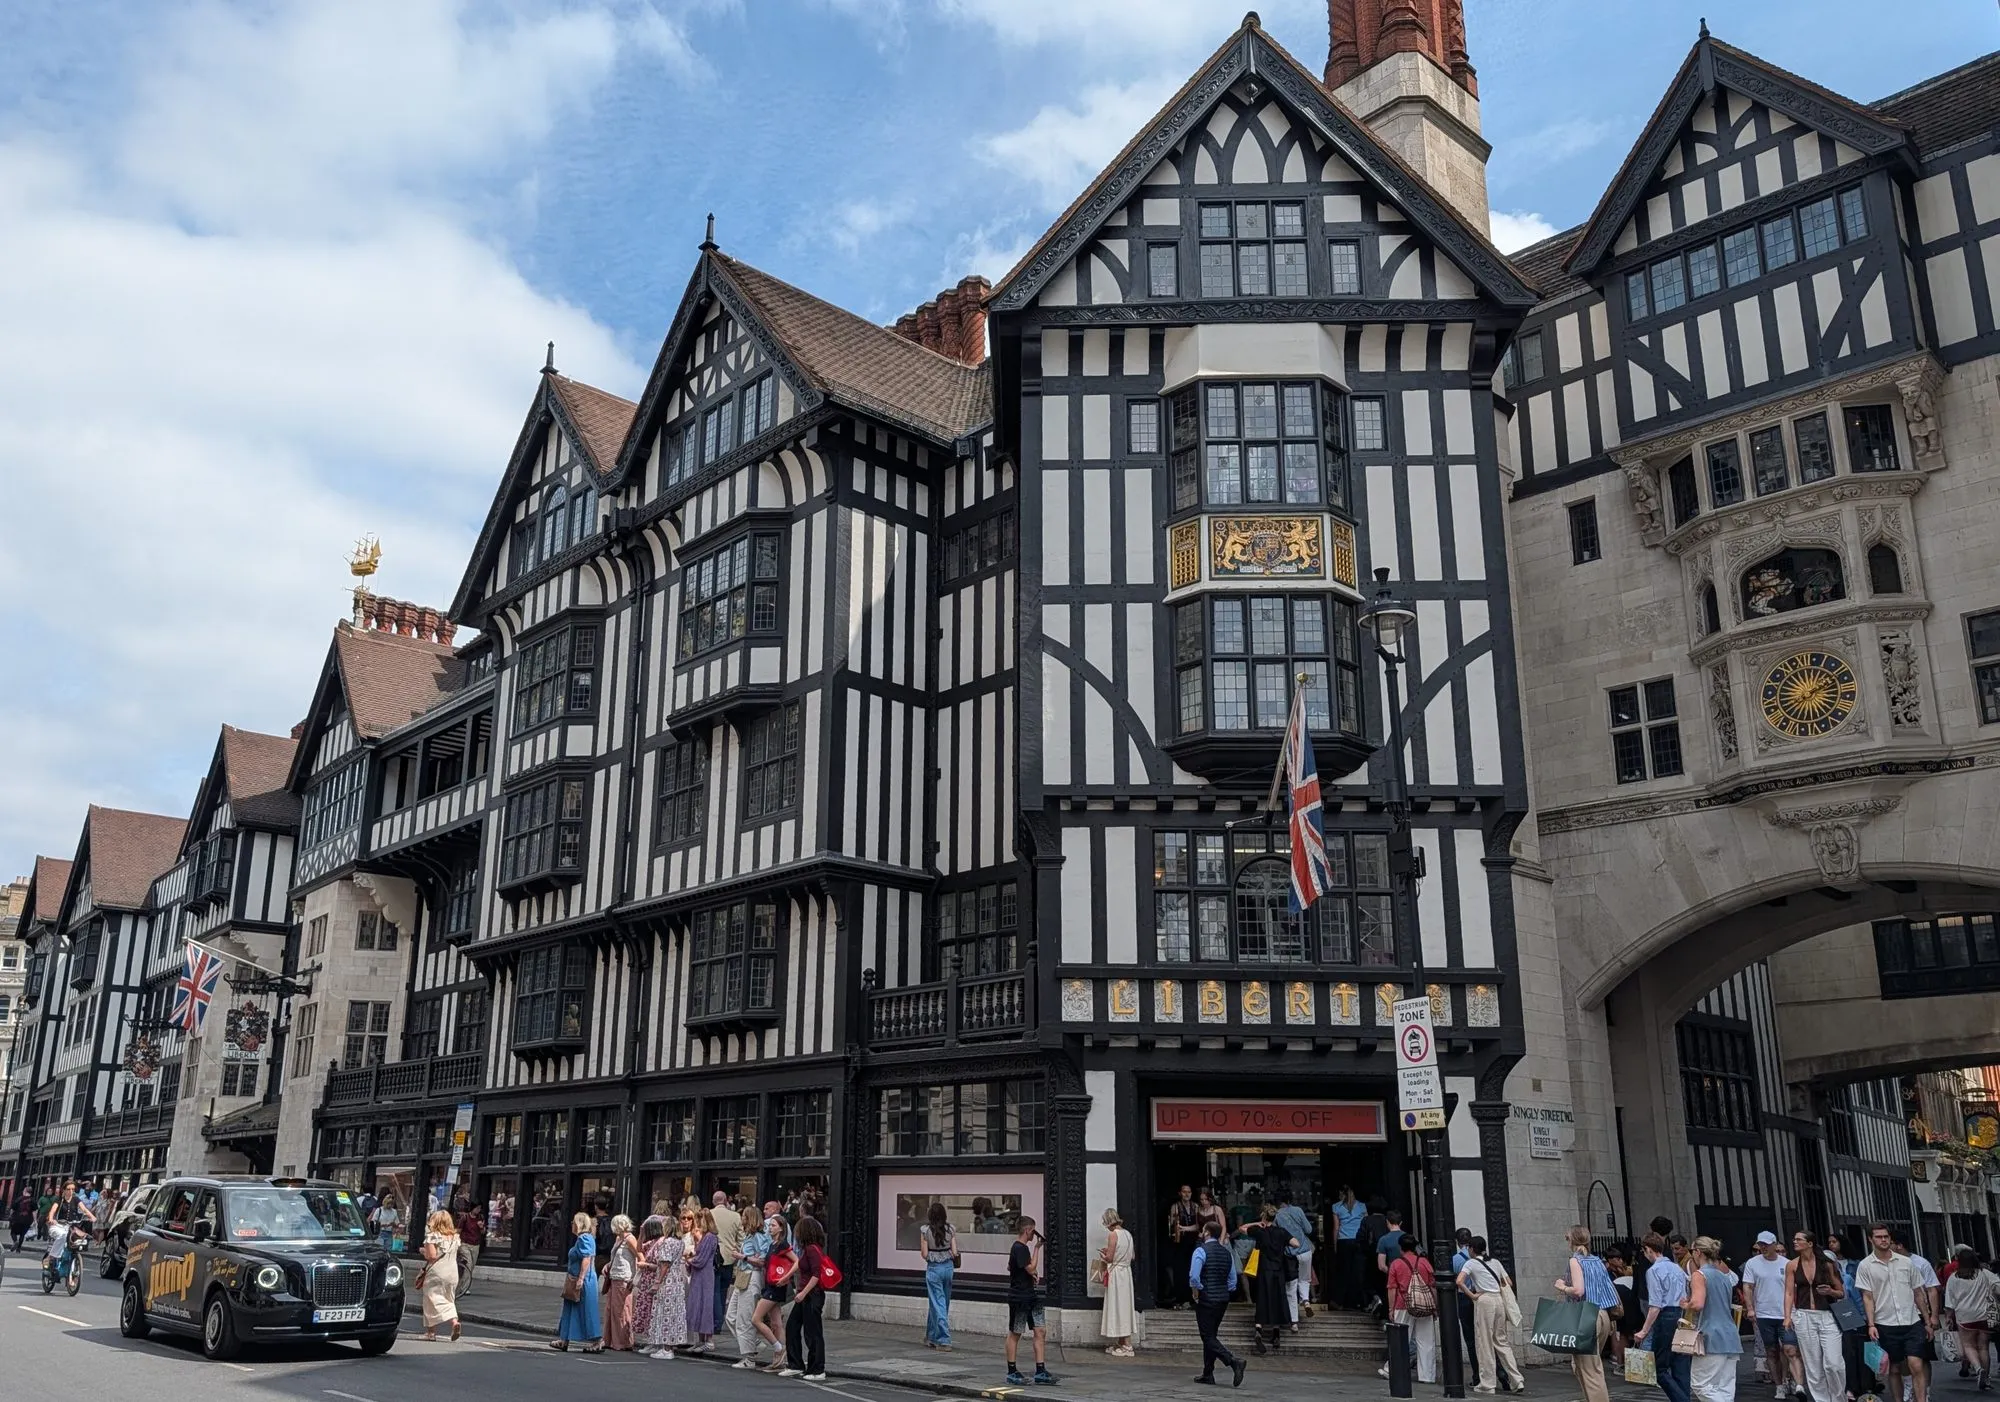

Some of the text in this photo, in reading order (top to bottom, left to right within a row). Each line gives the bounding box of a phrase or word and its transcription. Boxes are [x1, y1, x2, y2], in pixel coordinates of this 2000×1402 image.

[1951, 759, 1970, 768] VAIN
[1112, 986, 1400, 1018] LIBERTY
[1394, 1000, 1429, 1012] PEDESTRIAN
[1400, 1009, 1425, 1023] ZONE
[1402, 1069, 1433, 1080] Except for
[1407, 1077, 1430, 1087] loading
[1405, 1089, 1418, 1097] Mon
[1423, 1088, 1434, 1096] Sat
[1160, 1109, 1334, 1128] UP TO 70% OFF
[1420, 1111, 1440, 1120] At any
[1513, 1105, 1540, 1120] KINGLY
[1540, 1109, 1565, 1122] STREET
[1424, 1118, 1438, 1127] time
[1533, 1126, 1550, 1137] KINGLY
[1534, 1136, 1551, 1147] STREET
[146, 1251, 195, 1311] jump
[319, 1309, 363, 1321] LF23 FPZ
[1529, 1332, 1577, 1348] ANTLER
